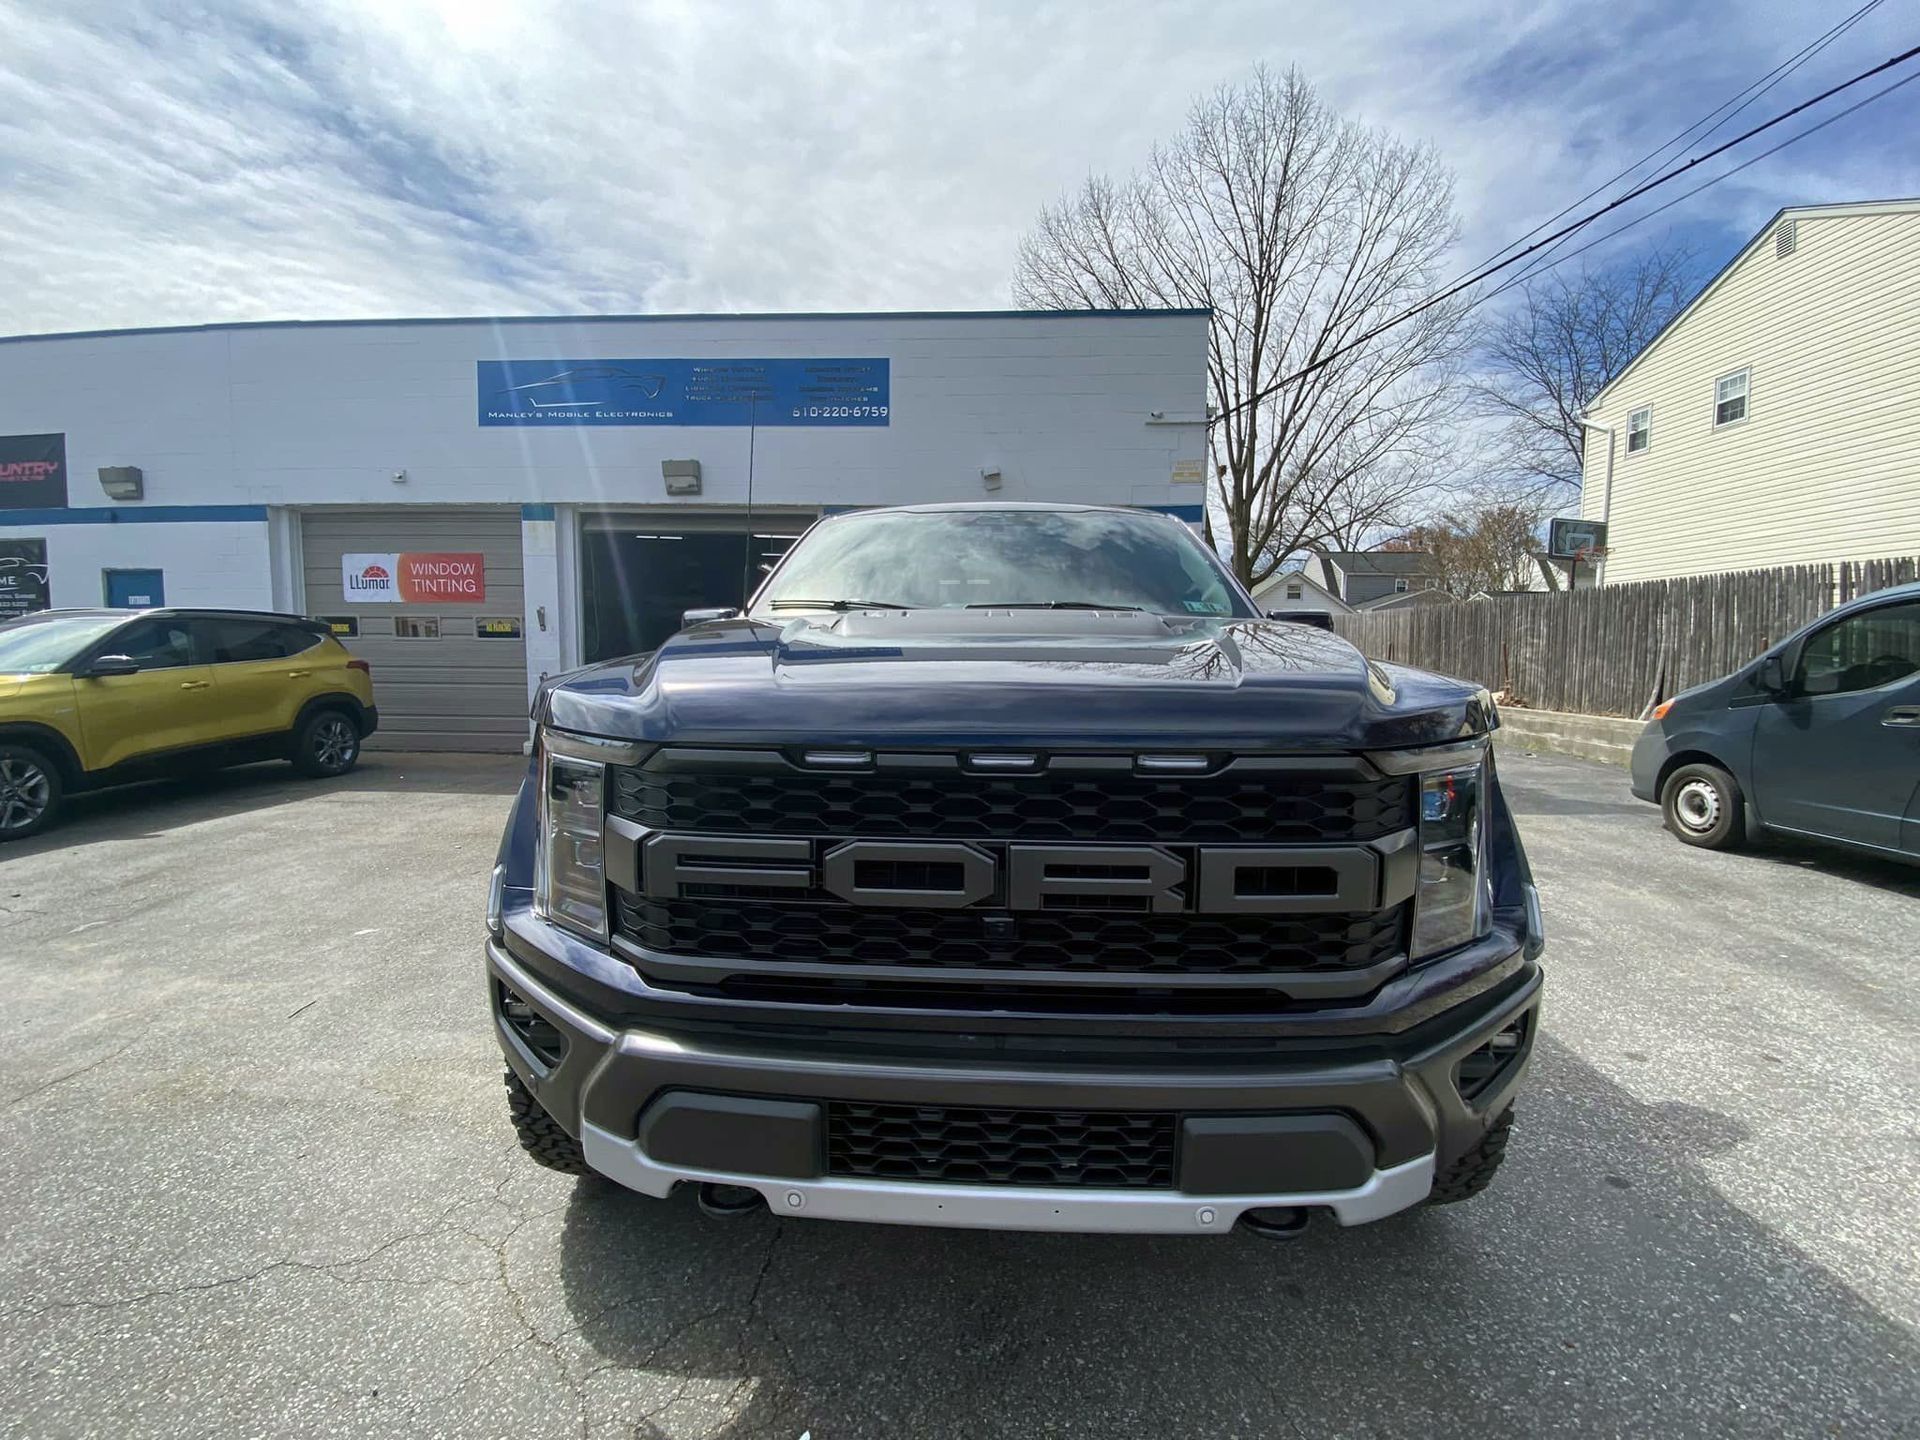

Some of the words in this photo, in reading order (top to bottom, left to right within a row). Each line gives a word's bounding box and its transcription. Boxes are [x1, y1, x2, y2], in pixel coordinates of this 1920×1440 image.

[488, 410, 543, 418] MANLEY'S
[548, 410, 590, 418] MOBILE
[595, 410, 673, 418] ELECTRONICS
[792, 406, 888, 417] 610-220-6759
[410, 562, 475, 576] WINDOW
[413, 578, 477, 593] TINTING
[645, 833, 1381, 914] FORD
